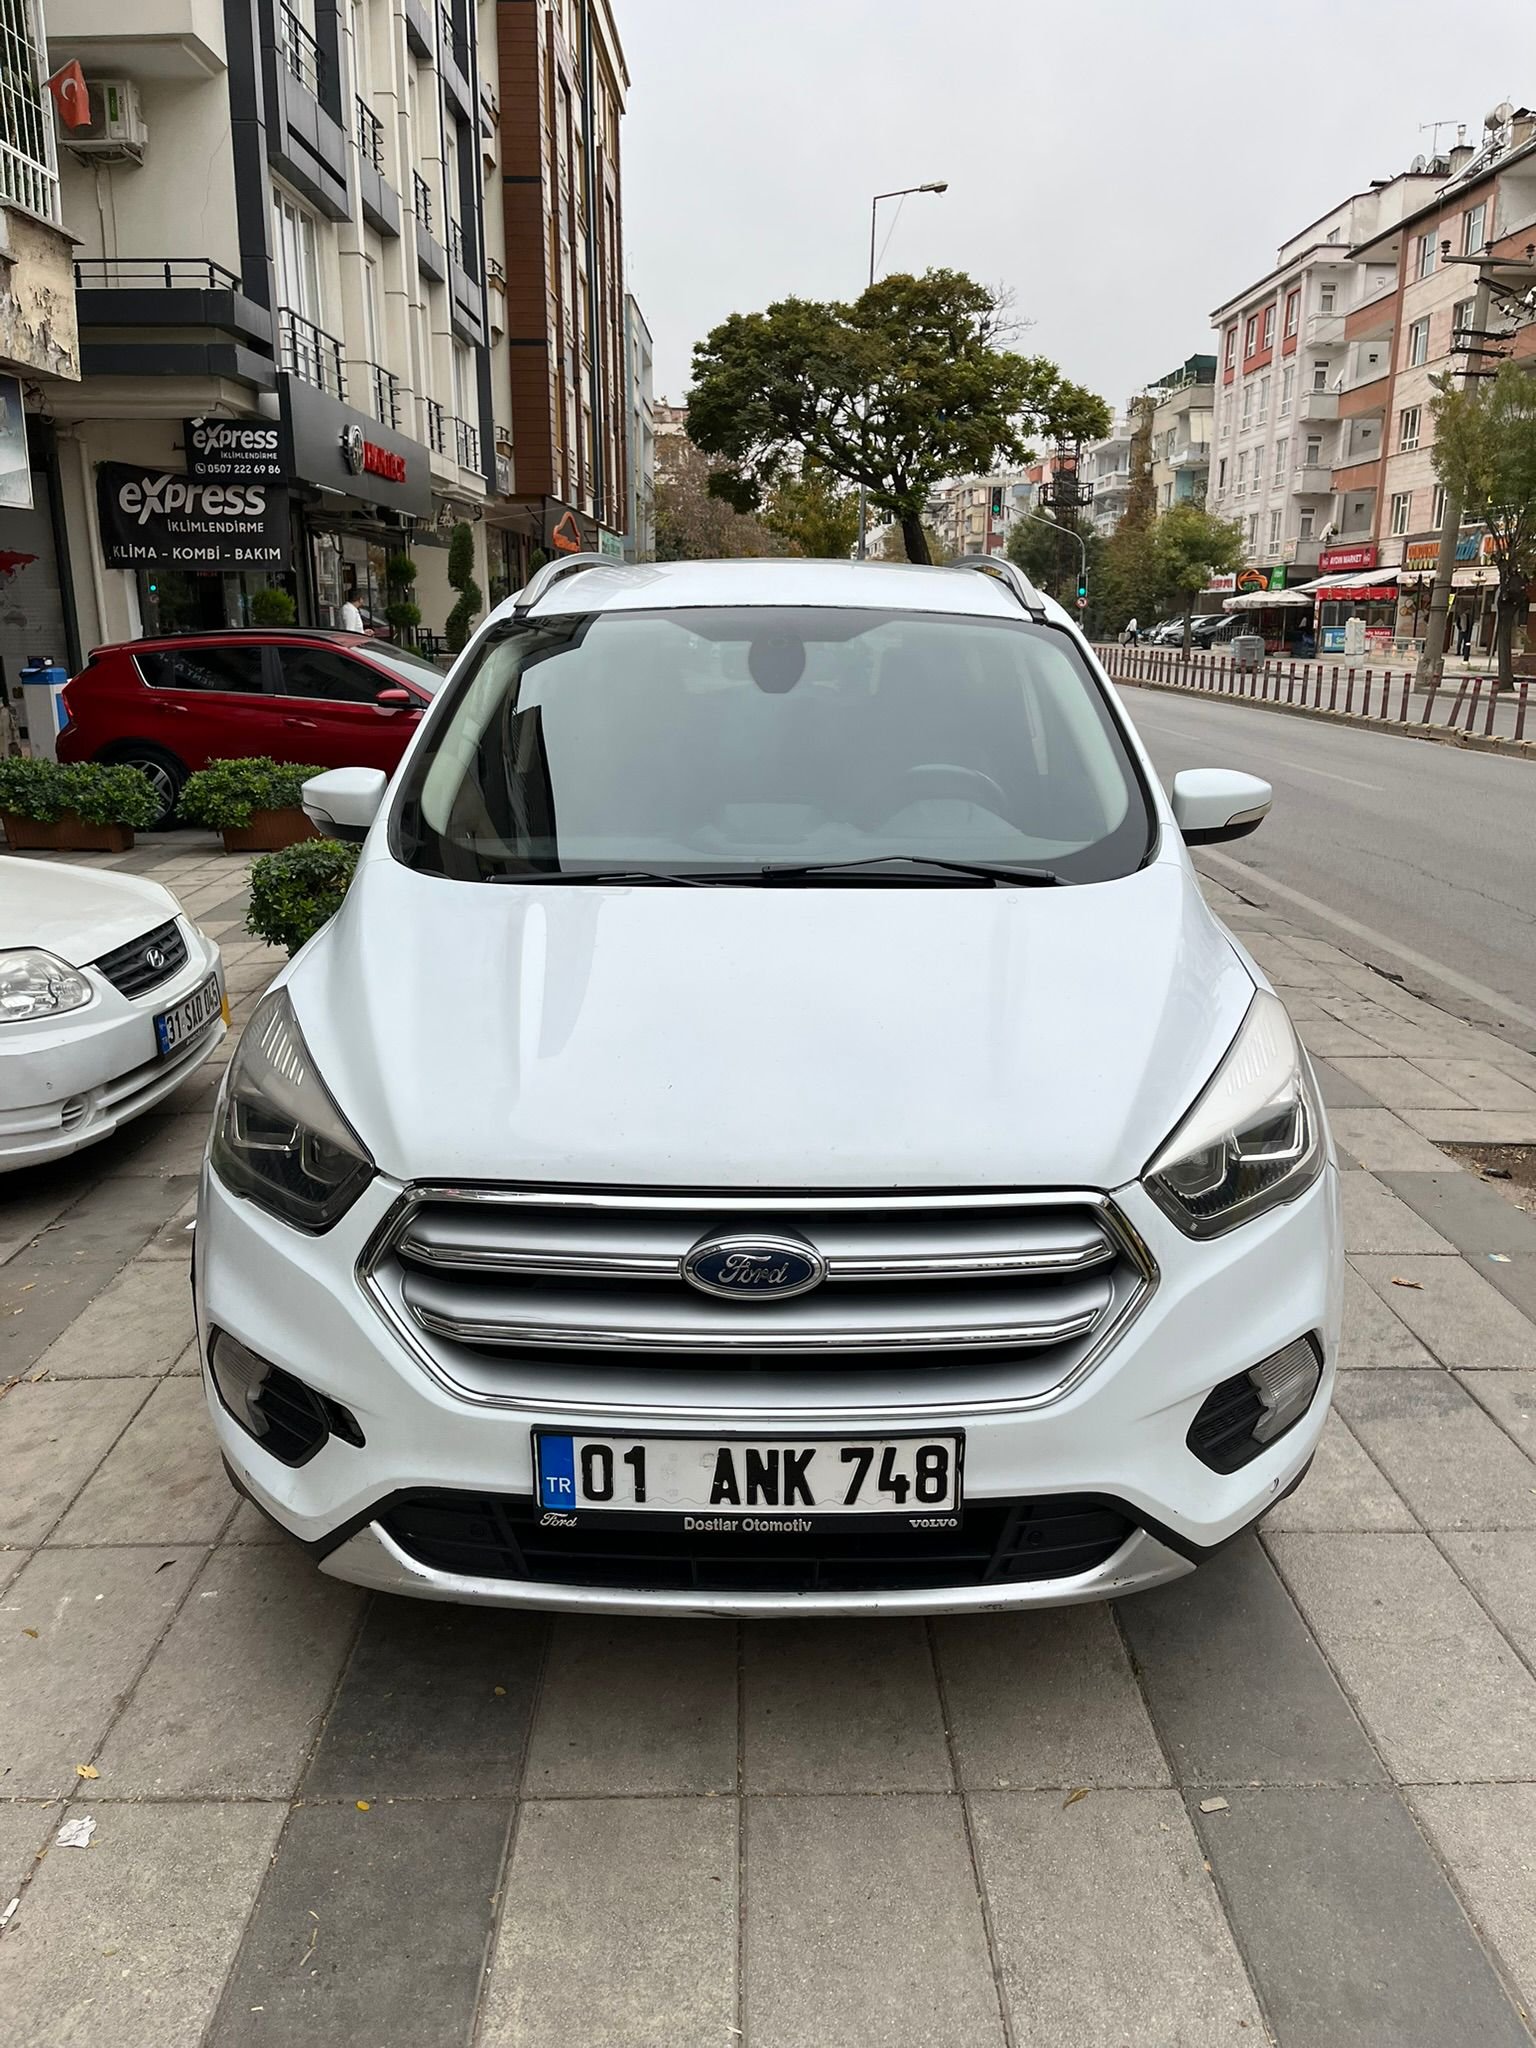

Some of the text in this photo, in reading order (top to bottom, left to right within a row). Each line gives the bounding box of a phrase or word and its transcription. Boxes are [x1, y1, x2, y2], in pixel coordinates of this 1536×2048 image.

[221, 451, 278, 460] İKLİMLENDİRME
[208, 464, 281, 474] 0507 222 69 86
[167, 519, 264, 533] İKLİMLENDİRME
[113, 544, 157, 558] KLİMA
[173, 545, 220, 560] KOMBİ
[235, 548, 281, 560] BAKIM
[166, 1011, 182, 1044] 31
[184, 995, 203, 1031] SAD
[717, 1253, 789, 1285] Ford
[580, 1444, 949, 1506] 01 ANK 748
[546, 1475, 572, 1494] TR
[539, 1512, 577, 1528] Ford
[684, 1516, 813, 1533] Dostlar Otomotiv
[909, 1518, 958, 1528] VOLVO
